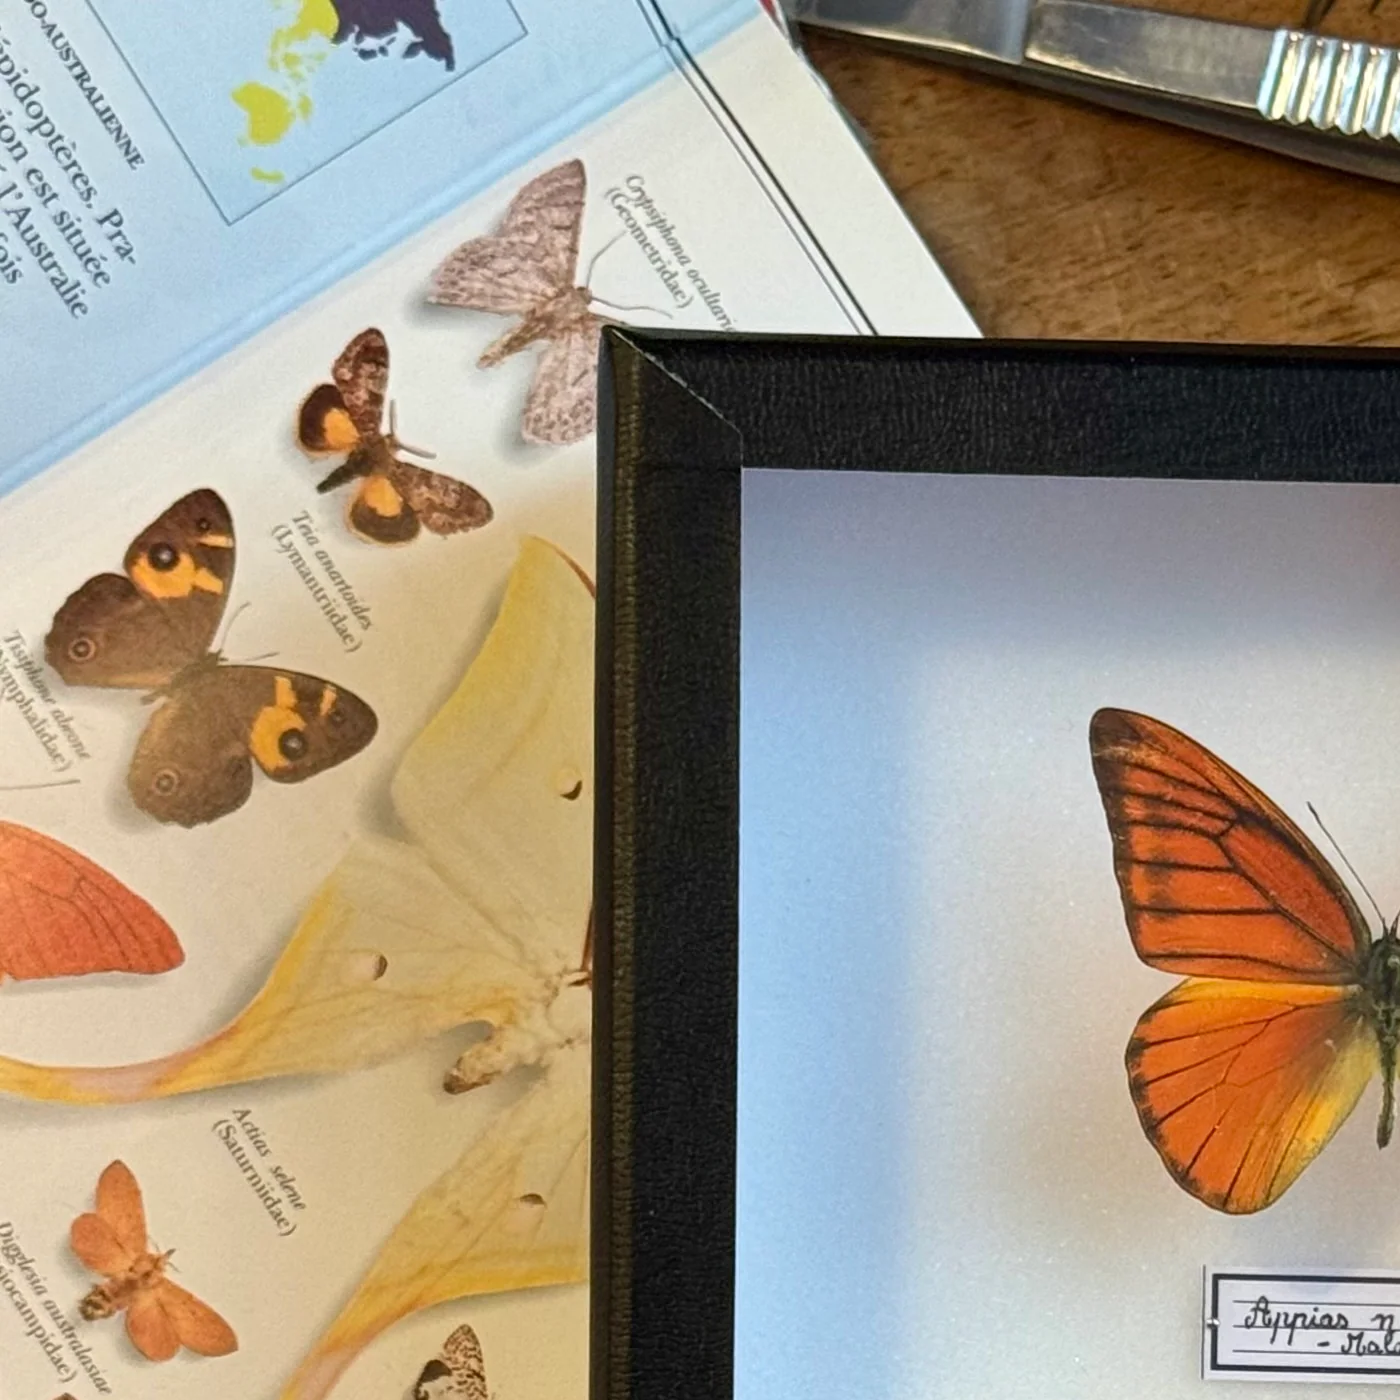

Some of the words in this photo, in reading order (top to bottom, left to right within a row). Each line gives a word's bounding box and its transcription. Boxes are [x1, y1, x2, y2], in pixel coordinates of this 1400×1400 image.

[24, 0, 145, 170] O-AUSTRALIENNE
[26, 166, 59, 208] est
[53, 209, 111, 288] située
[97, 208, 136, 265] Pra-
[603, 187, 694, 308] (Geometridae)
[271, 524, 363, 653] (Lymantriidae)
[211, 1119, 297, 1237] (Saturniidae)
[232, 1108, 272, 1157] Actias
[269, 1165, 306, 1209] selene
[0, 1221, 48, 1296] Digglesia
[42, 1299, 112, 1395] australasiae
[1244, 1295, 1350, 1345] Appias
